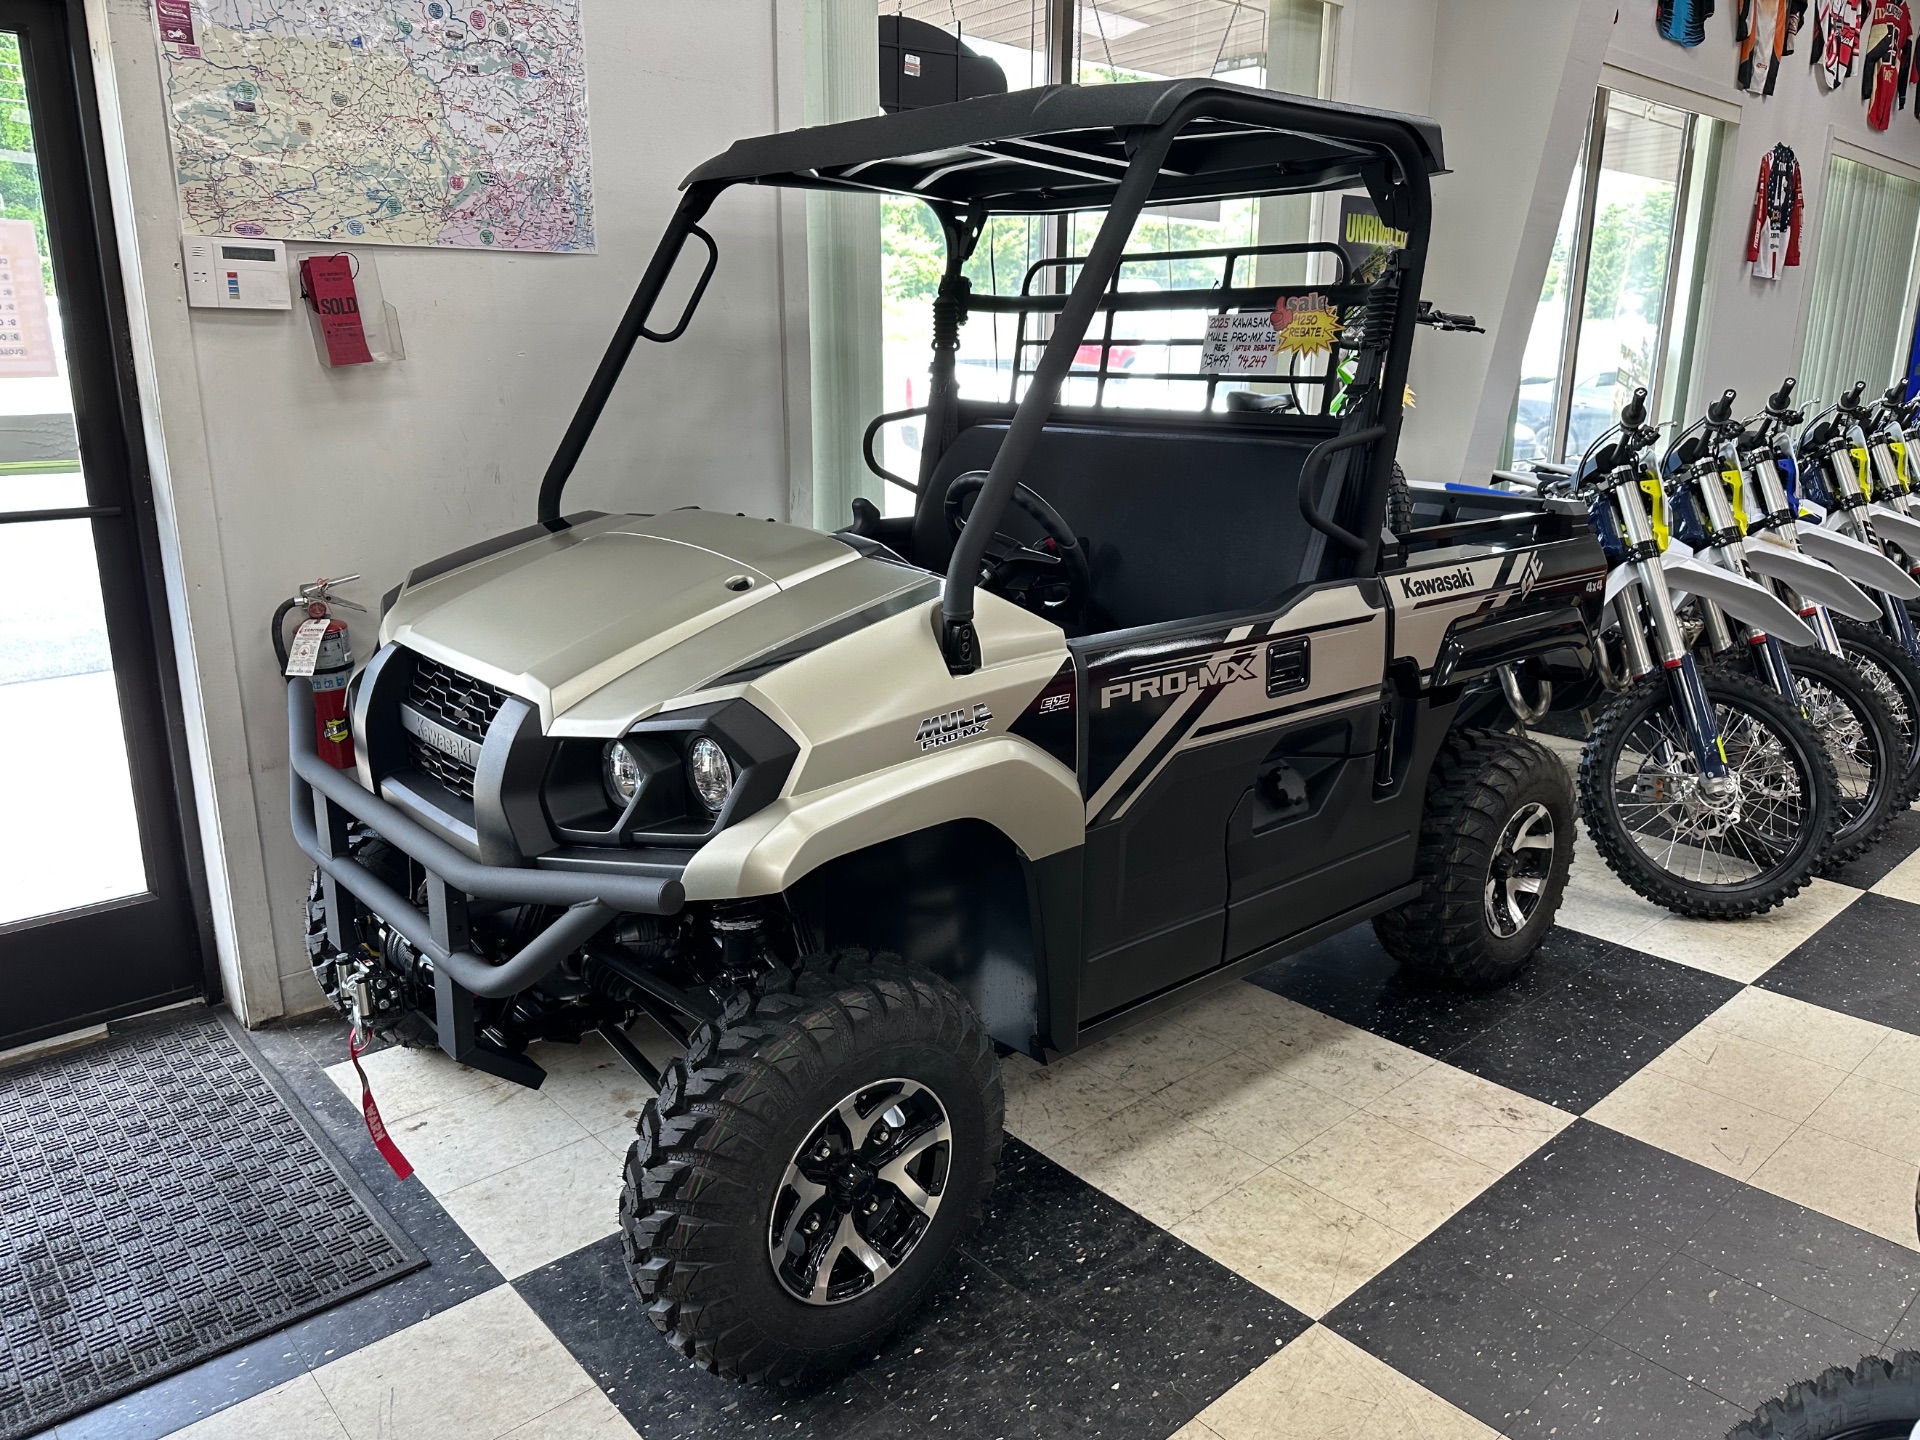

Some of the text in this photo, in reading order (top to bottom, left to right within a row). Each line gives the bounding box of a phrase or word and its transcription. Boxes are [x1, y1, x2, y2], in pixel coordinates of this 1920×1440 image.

[320, 296, 358, 315] SOLD
[1287, 292, 1329, 312] sale
[1209, 317, 1230, 329] 2025
[1207, 331, 1228, 343] MULE
[1265, 331, 1277, 343] SE
[1213, 343, 1276, 352] REG AFTER REBATE
[1400, 567, 1475, 598] Kawasaki
[1585, 579, 1603, 593] 4x4
[1101, 654, 1258, 709] PRO-MX
[1040, 693, 1070, 709] EPS
[914, 702, 994, 743] MULE
[417, 716, 472, 764] Kawasaki
[921, 721, 989, 751] PRO-MX
[365, 1102, 386, 1142] WARN
